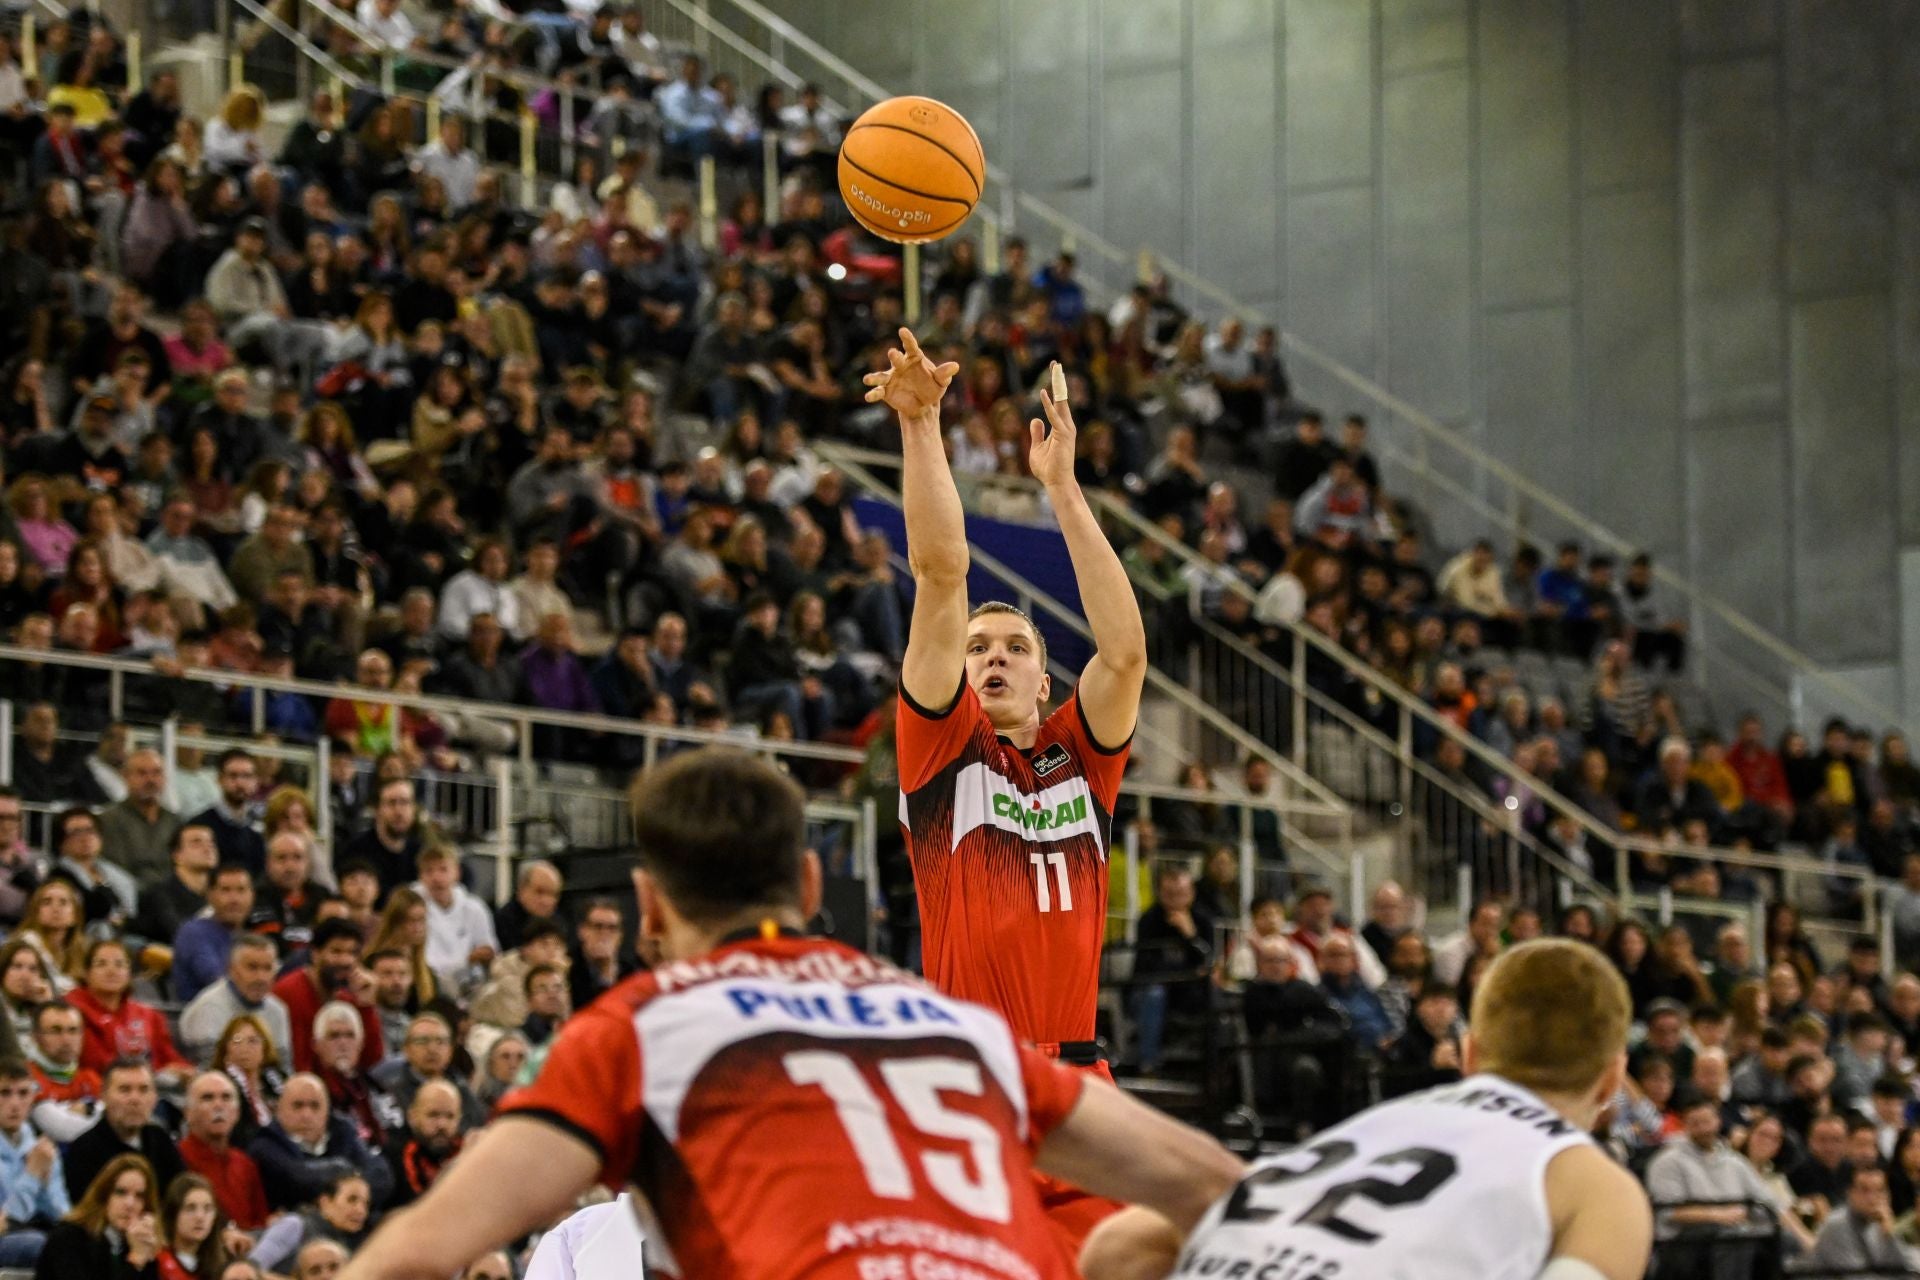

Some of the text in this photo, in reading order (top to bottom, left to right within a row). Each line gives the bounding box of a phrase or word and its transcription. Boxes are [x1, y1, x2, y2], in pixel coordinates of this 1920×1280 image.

[851, 183, 932, 224] liga endesa
[1039, 753, 1067, 773] endesa
[1030, 852, 1073, 912] 11
[782, 1050, 1013, 1225] 15
[1220, 1139, 1462, 1244] 22
